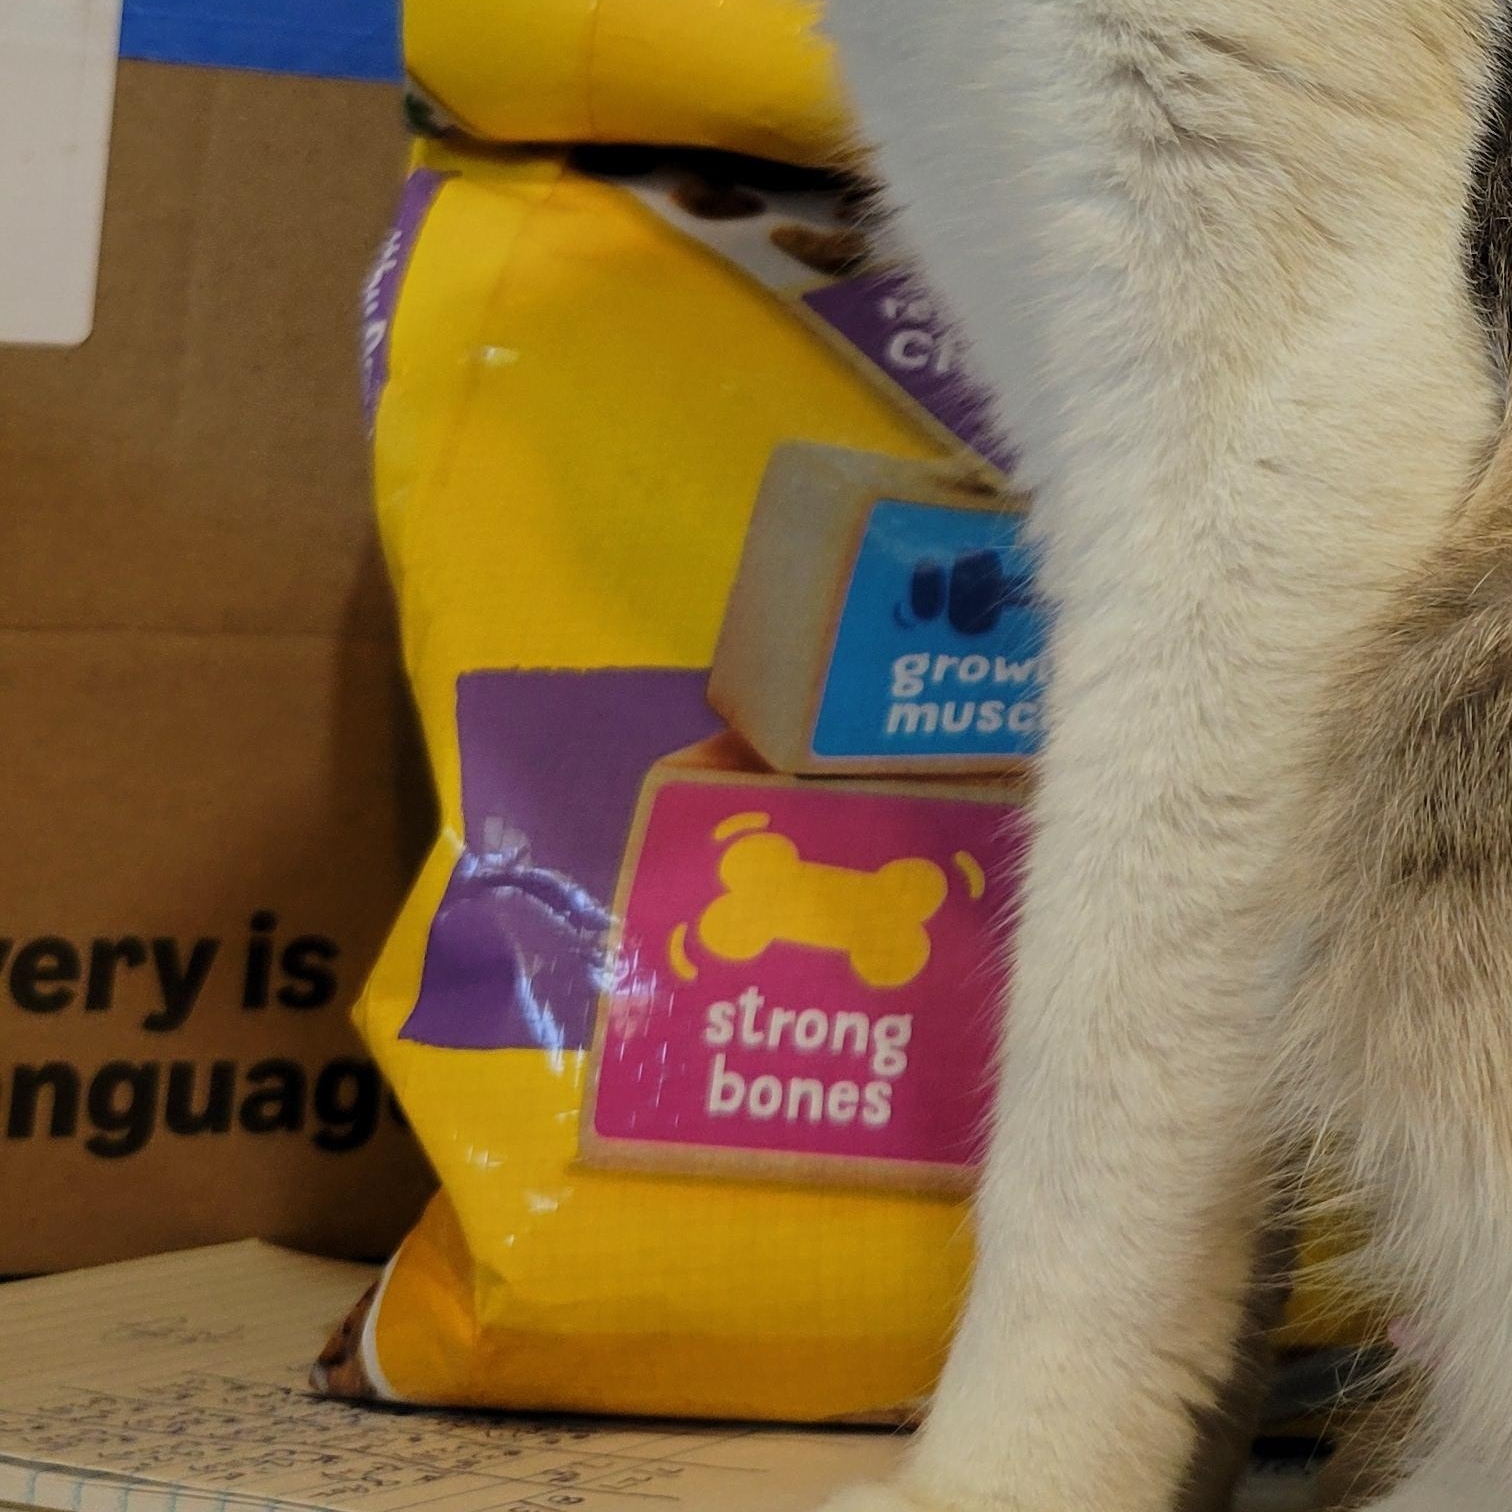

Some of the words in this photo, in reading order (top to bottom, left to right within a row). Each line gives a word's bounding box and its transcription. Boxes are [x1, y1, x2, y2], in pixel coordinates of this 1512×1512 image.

[891, 652, 1044, 698] grow
[886, 699, 1042, 735] musc
[0, 934, 220, 1033] ery
[242, 910, 340, 1011] is
[703, 985, 914, 1078] strong
[0, 1054, 410, 1160] nguag
[706, 1054, 894, 1127] bones
